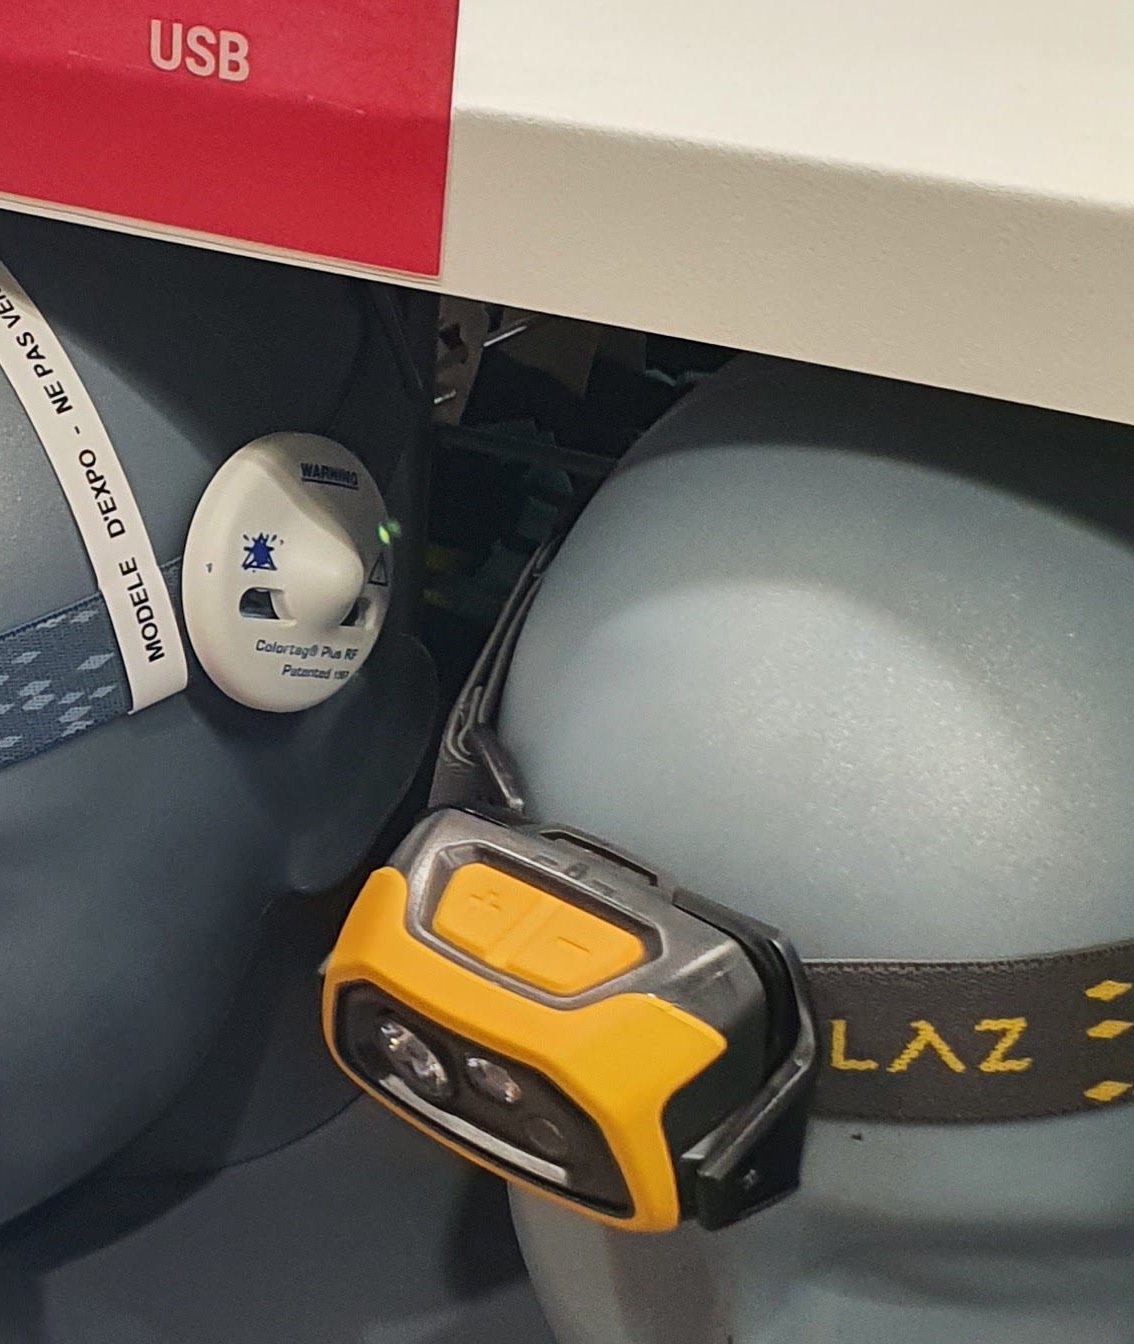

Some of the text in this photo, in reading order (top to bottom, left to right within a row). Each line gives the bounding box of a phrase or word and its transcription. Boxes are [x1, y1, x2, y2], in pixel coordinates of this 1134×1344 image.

[150, 18, 251, 82] USB
[16, 331, 54, 378] PAS
[43, 381, 73, 415] NE
[78, 449, 126, 538] D'EXPO
[300, 462, 359, 487] WARNING
[118, 557, 166, 663] MODELE
[282, 664, 331, 680] Patented
[321, 645, 343, 660] Plus
[344, 648, 359, 661] RF
